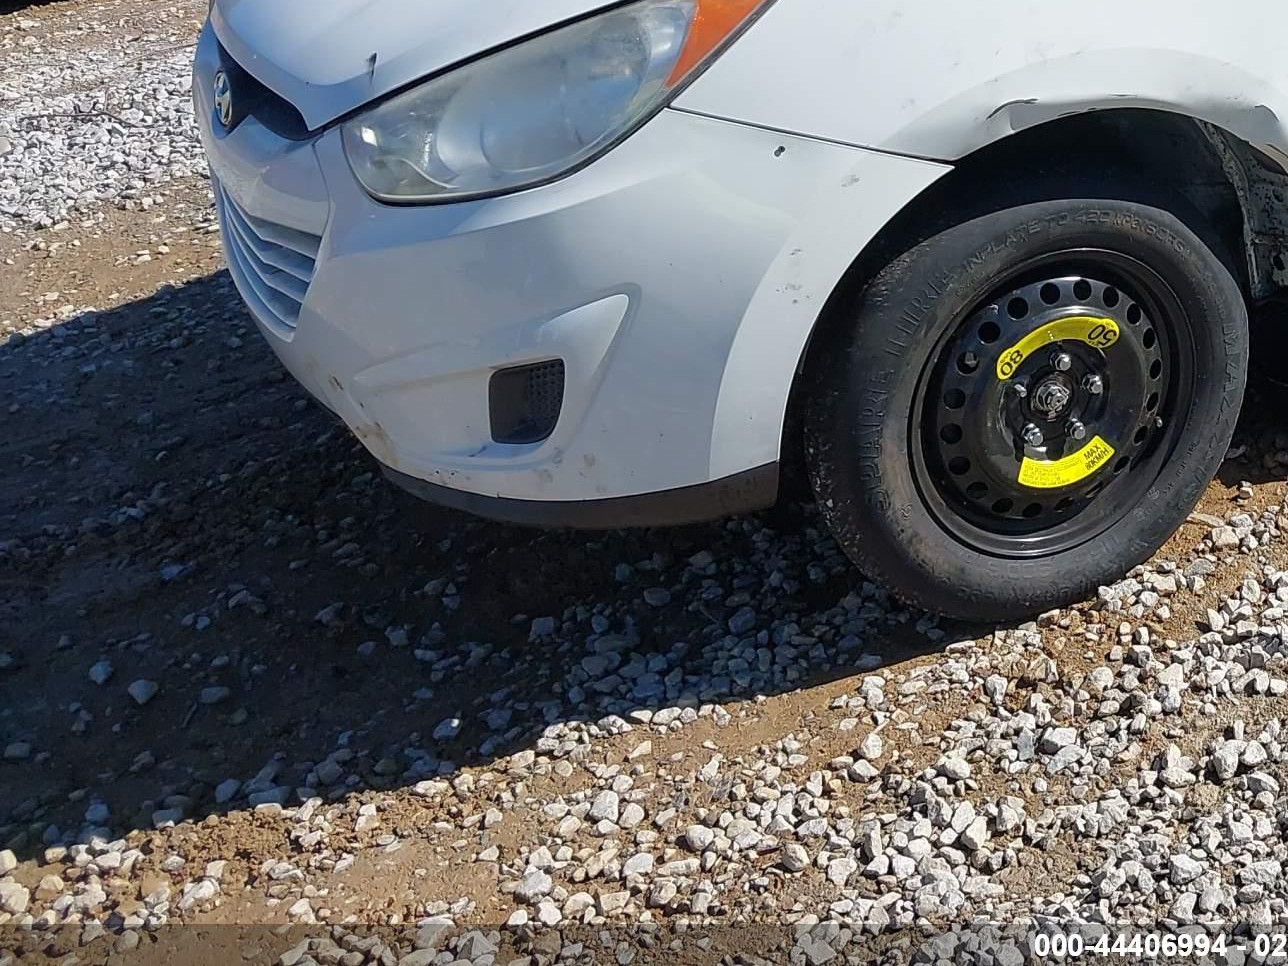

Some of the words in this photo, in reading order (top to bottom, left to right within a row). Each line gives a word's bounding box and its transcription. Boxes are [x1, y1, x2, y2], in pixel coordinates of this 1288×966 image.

[1088, 324, 1117, 346] 50
[1000, 350, 1024, 376] 80
[1083, 444, 1101, 460] MAX
